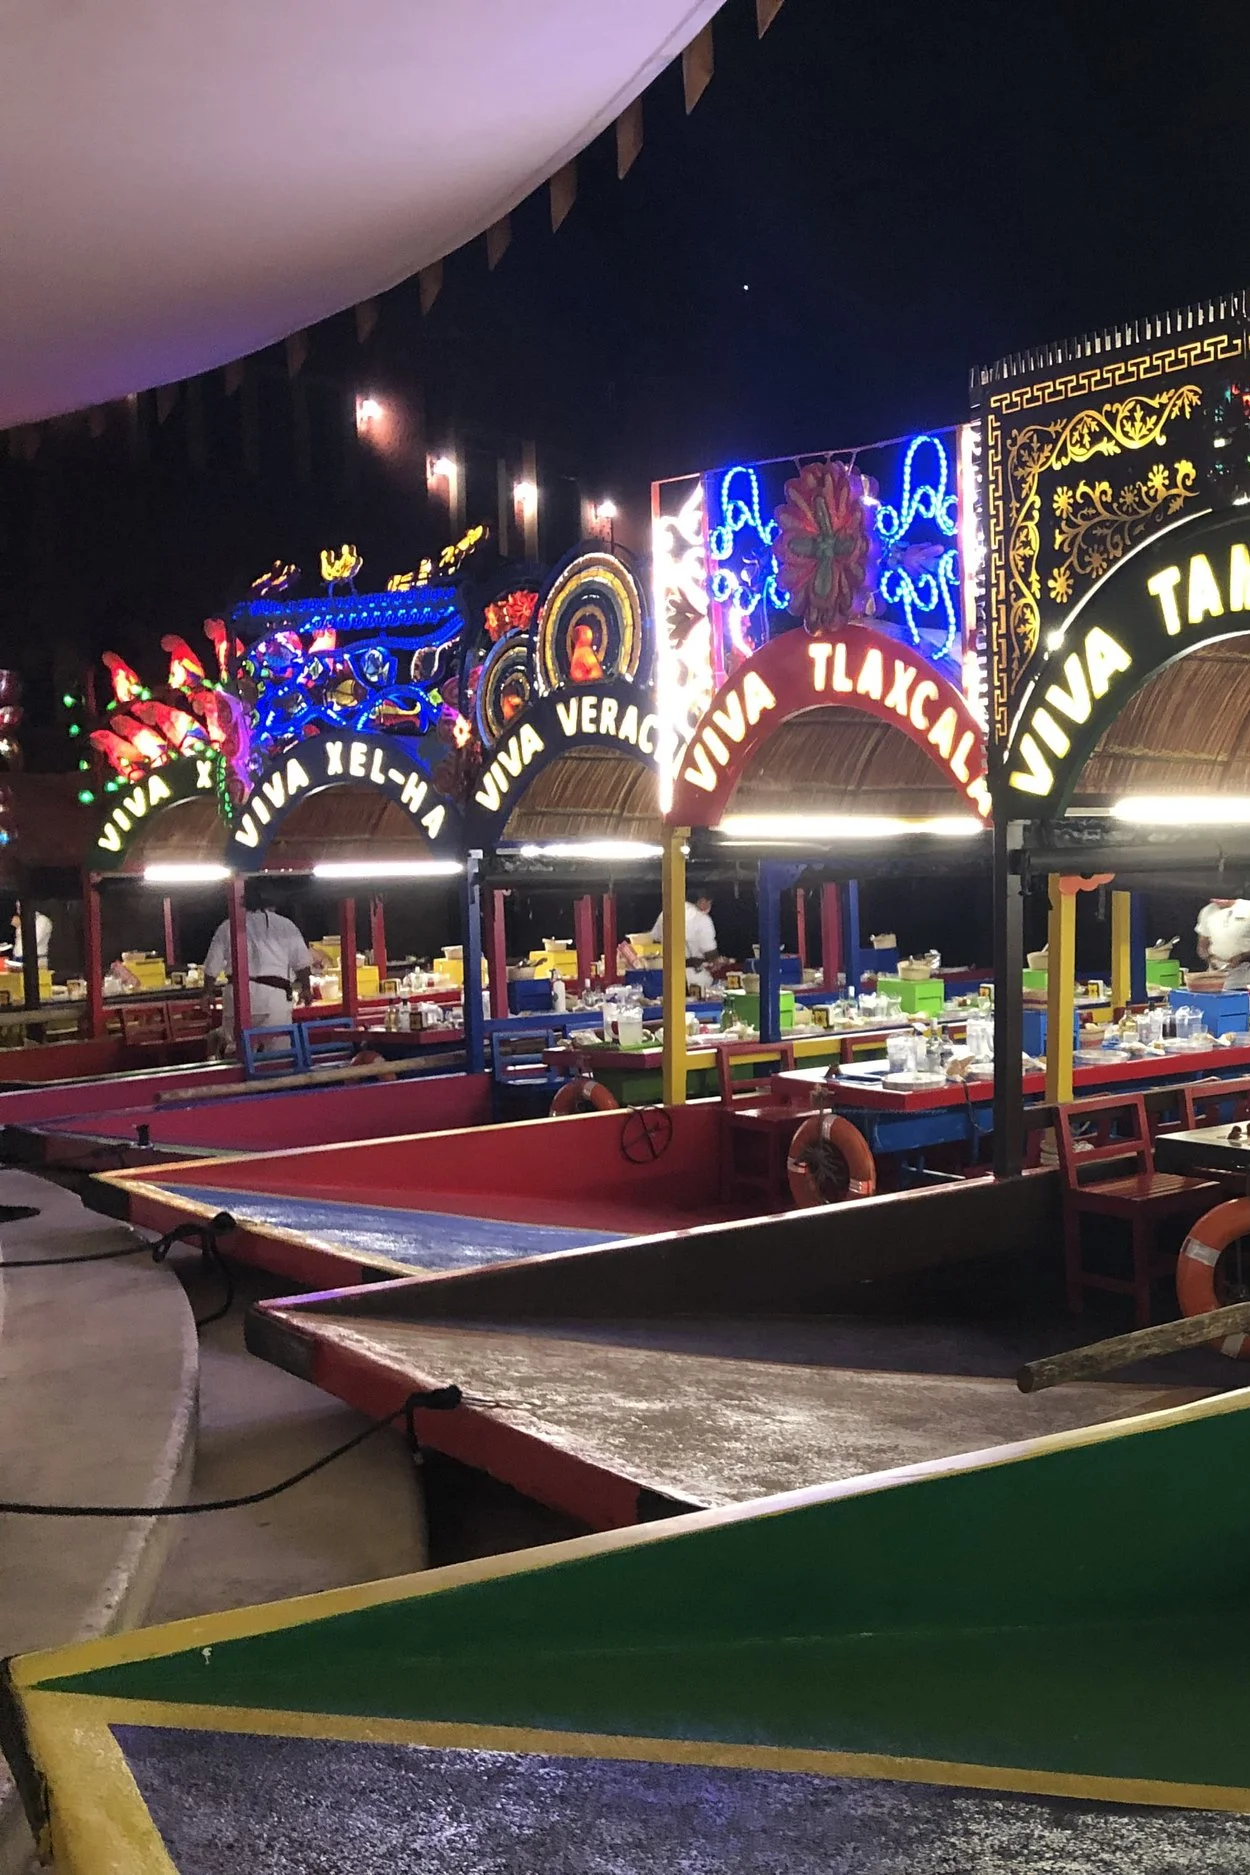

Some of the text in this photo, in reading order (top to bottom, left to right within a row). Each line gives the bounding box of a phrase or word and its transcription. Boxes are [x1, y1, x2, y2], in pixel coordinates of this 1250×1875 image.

[683, 671, 777, 792] VIVA
[1008, 626, 1132, 796] VIVA
[98, 775, 171, 851] VIVA
[235, 741, 446, 848] VIVA XEL-HA
[475, 723, 545, 812] VIVA
